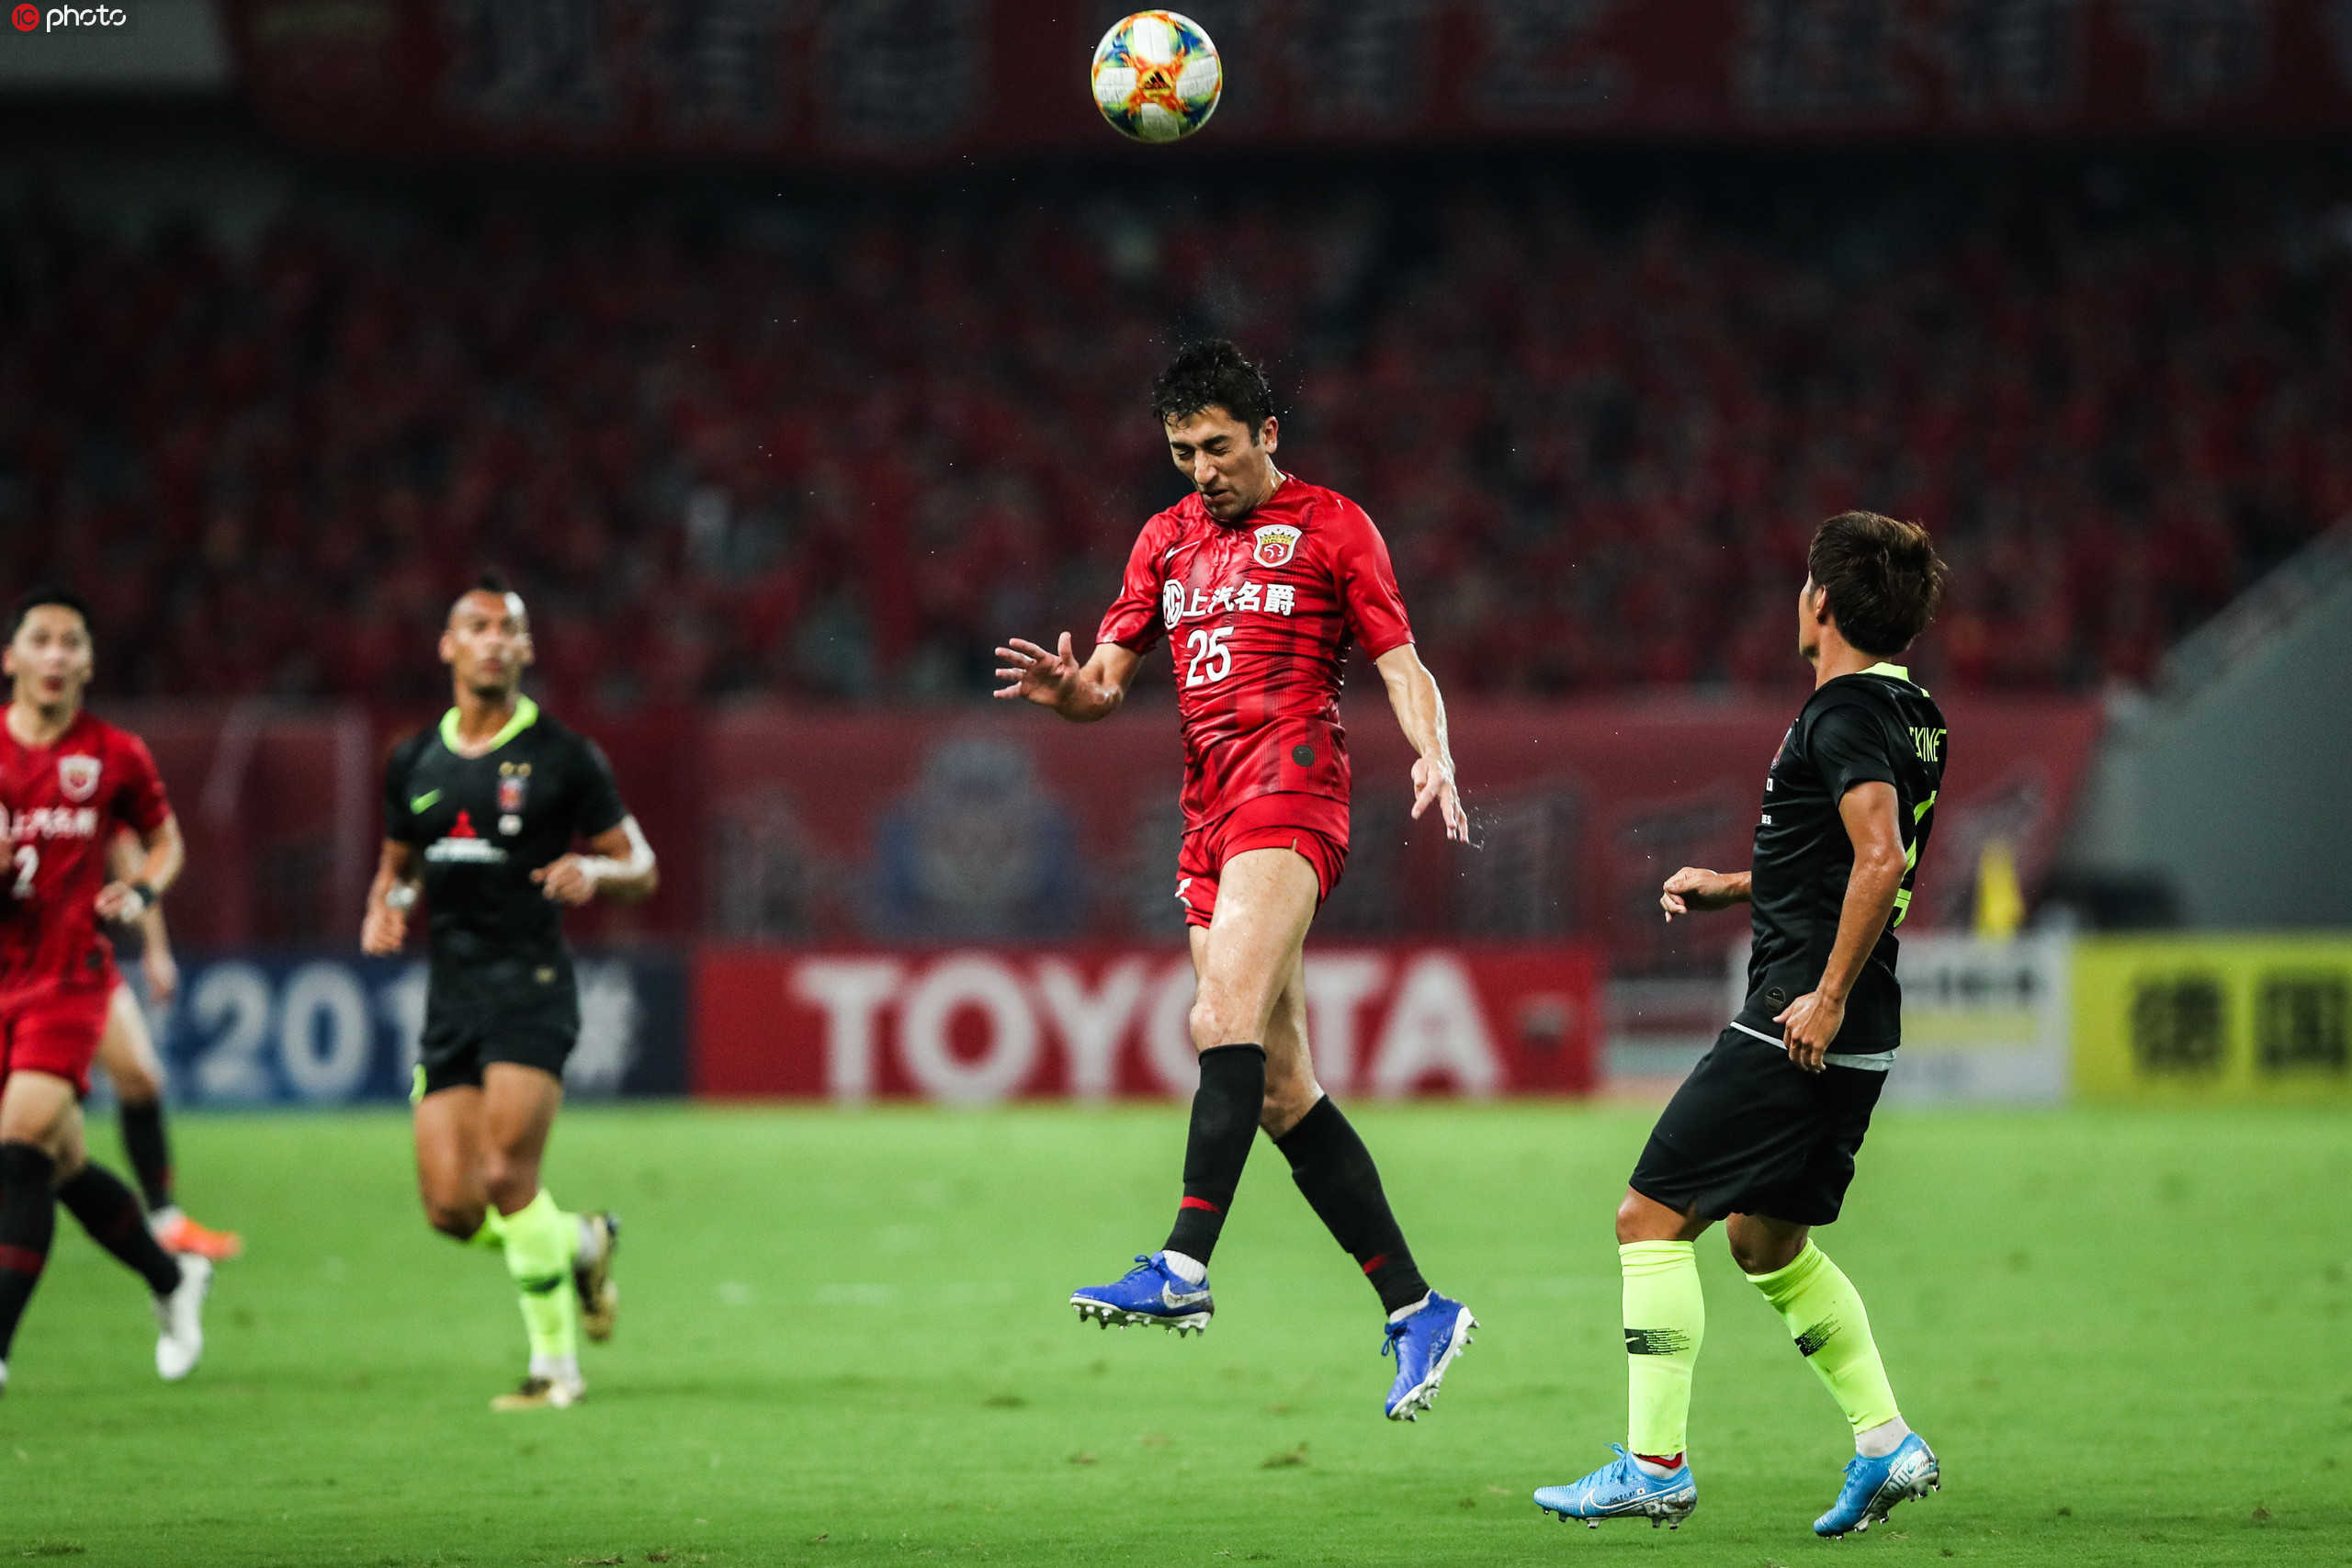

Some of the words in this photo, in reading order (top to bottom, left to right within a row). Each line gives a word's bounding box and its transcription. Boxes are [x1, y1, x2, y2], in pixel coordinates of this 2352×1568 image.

[1182, 581, 1296, 616] 上汽名爵
[1185, 626, 1235, 687] 25
[1909, 727, 1947, 762] KINE
